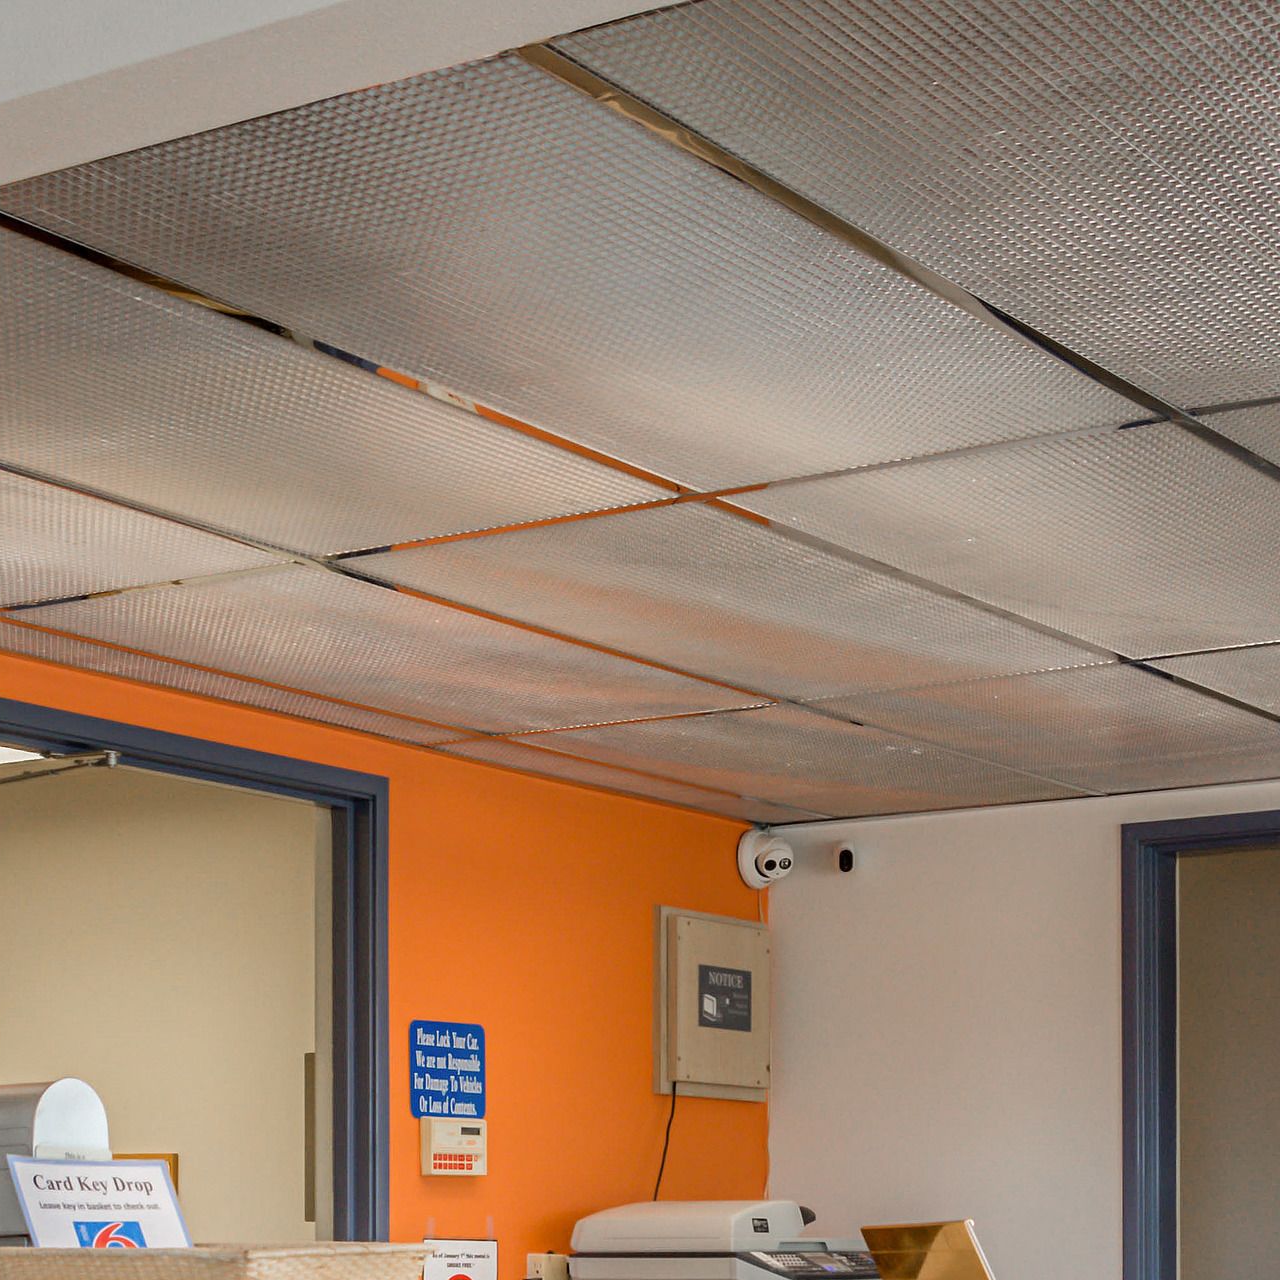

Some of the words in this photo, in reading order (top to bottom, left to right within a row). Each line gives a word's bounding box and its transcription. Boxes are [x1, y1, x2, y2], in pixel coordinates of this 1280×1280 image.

[708, 971, 744, 989] NOTICE
[416, 1027, 435, 1047] Please
[436, 1029, 451, 1048] Lock
[452, 1031, 466, 1049] Your
[415, 1050, 426, 1068] We
[426, 1055, 436, 1068] are
[436, 1055, 447, 1069] not
[447, 1053, 481, 1075] Responsible
[414, 1072, 424, 1090] For
[425, 1073, 449, 1096] Damage
[450, 1075, 458, 1092] To
[459, 1075, 482, 1094] Vehicles
[419, 1095, 428, 1113] Or
[428, 1096, 442, 1114] Loss
[443, 1096, 449, 1114] of
[32, 1174, 73, 1191] Card
[77, 1175, 109, 1195] Key
[112, 1176, 154, 1196] Drop
[39, 1200, 61, 1210] Leave
[62, 1202, 76, 1211] key
[77, 1202, 86, 1210] in
[86, 1202, 113, 1210] basket
[123, 1202, 144, 1210] check
